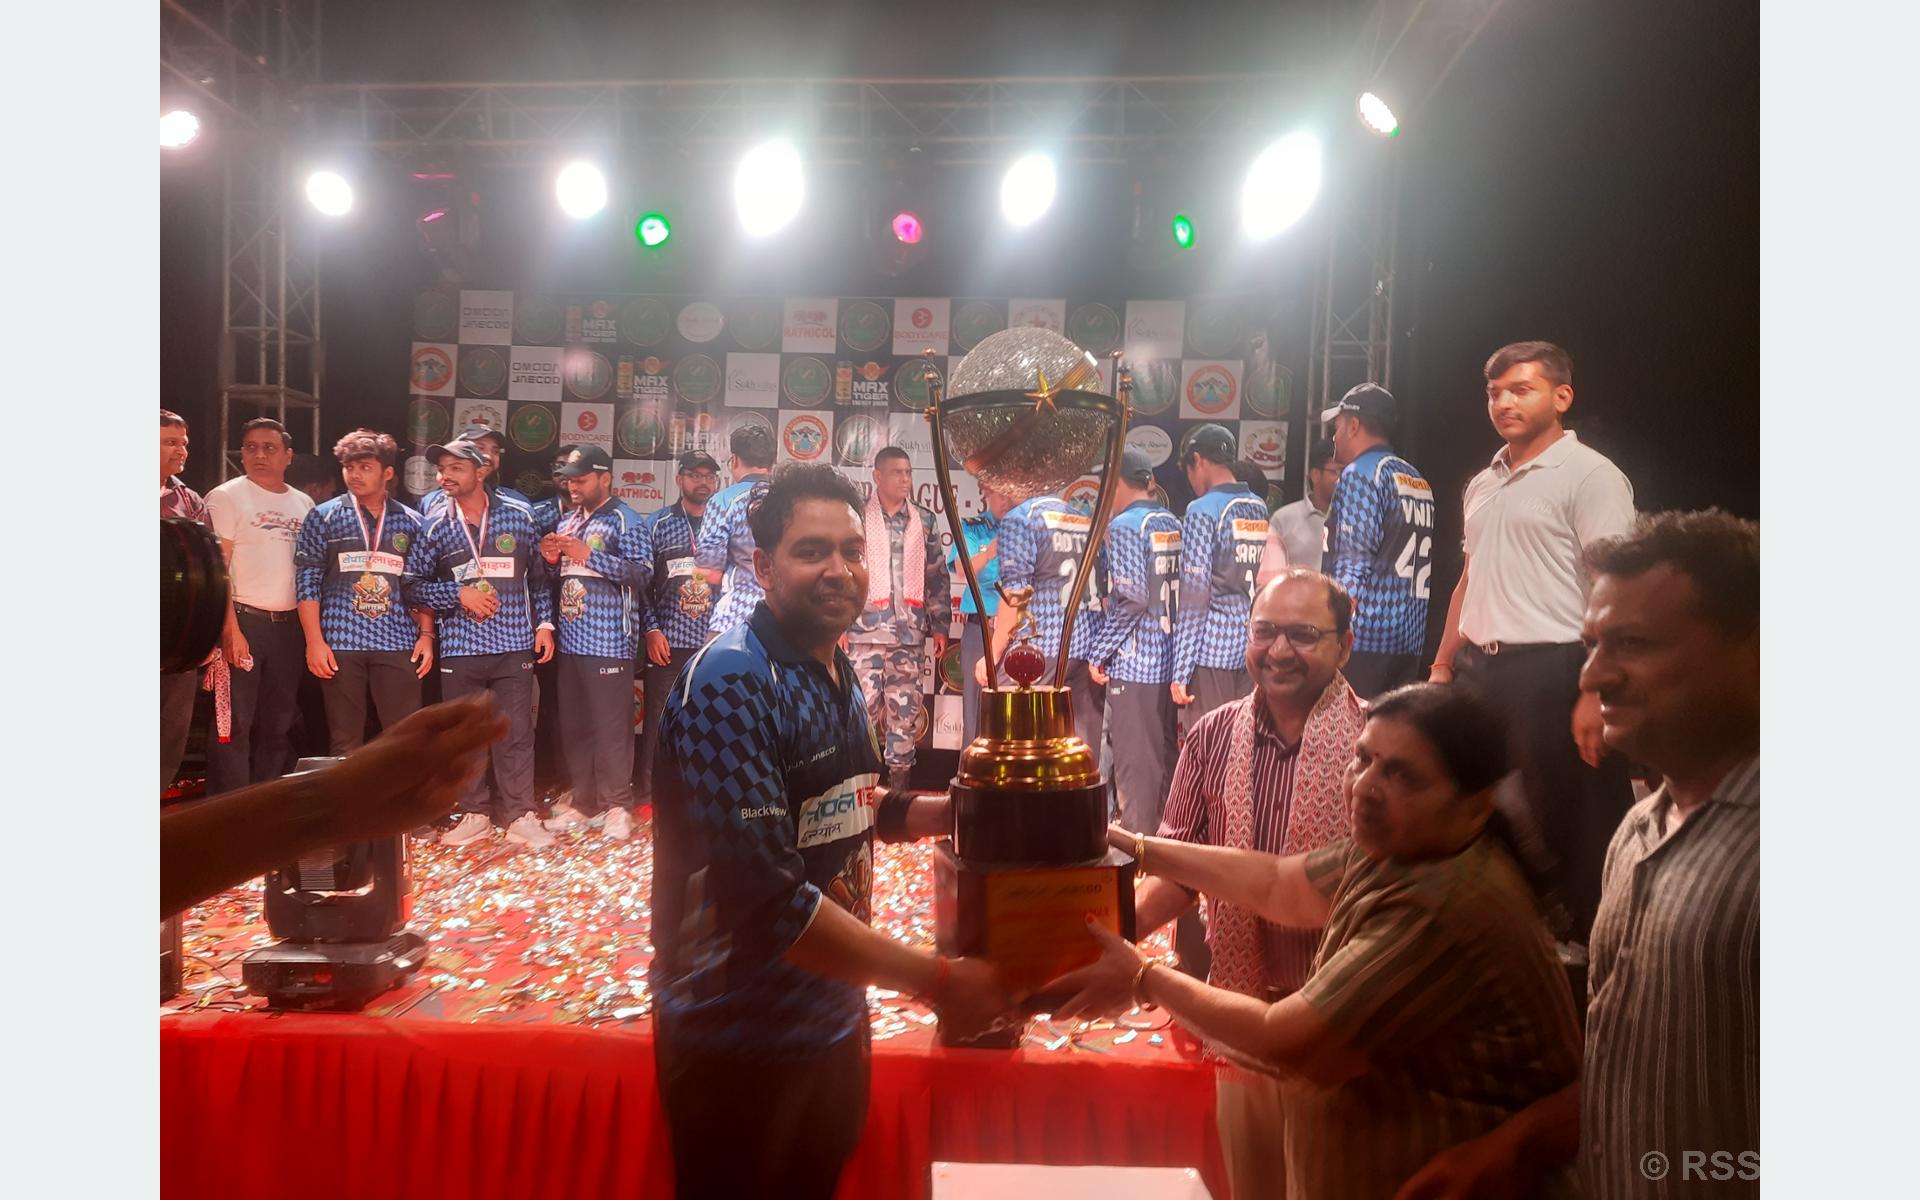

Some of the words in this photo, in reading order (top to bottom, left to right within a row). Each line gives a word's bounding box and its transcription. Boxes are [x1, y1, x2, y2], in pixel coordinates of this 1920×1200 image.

[583, 319, 616, 330] MAX
[634, 375, 669, 387] MAX
[853, 381, 889, 393] MAX
[853, 393, 889, 401] TIGER
[560, 432, 613, 442] BODYCARE
[1395, 532, 1432, 599] 42
